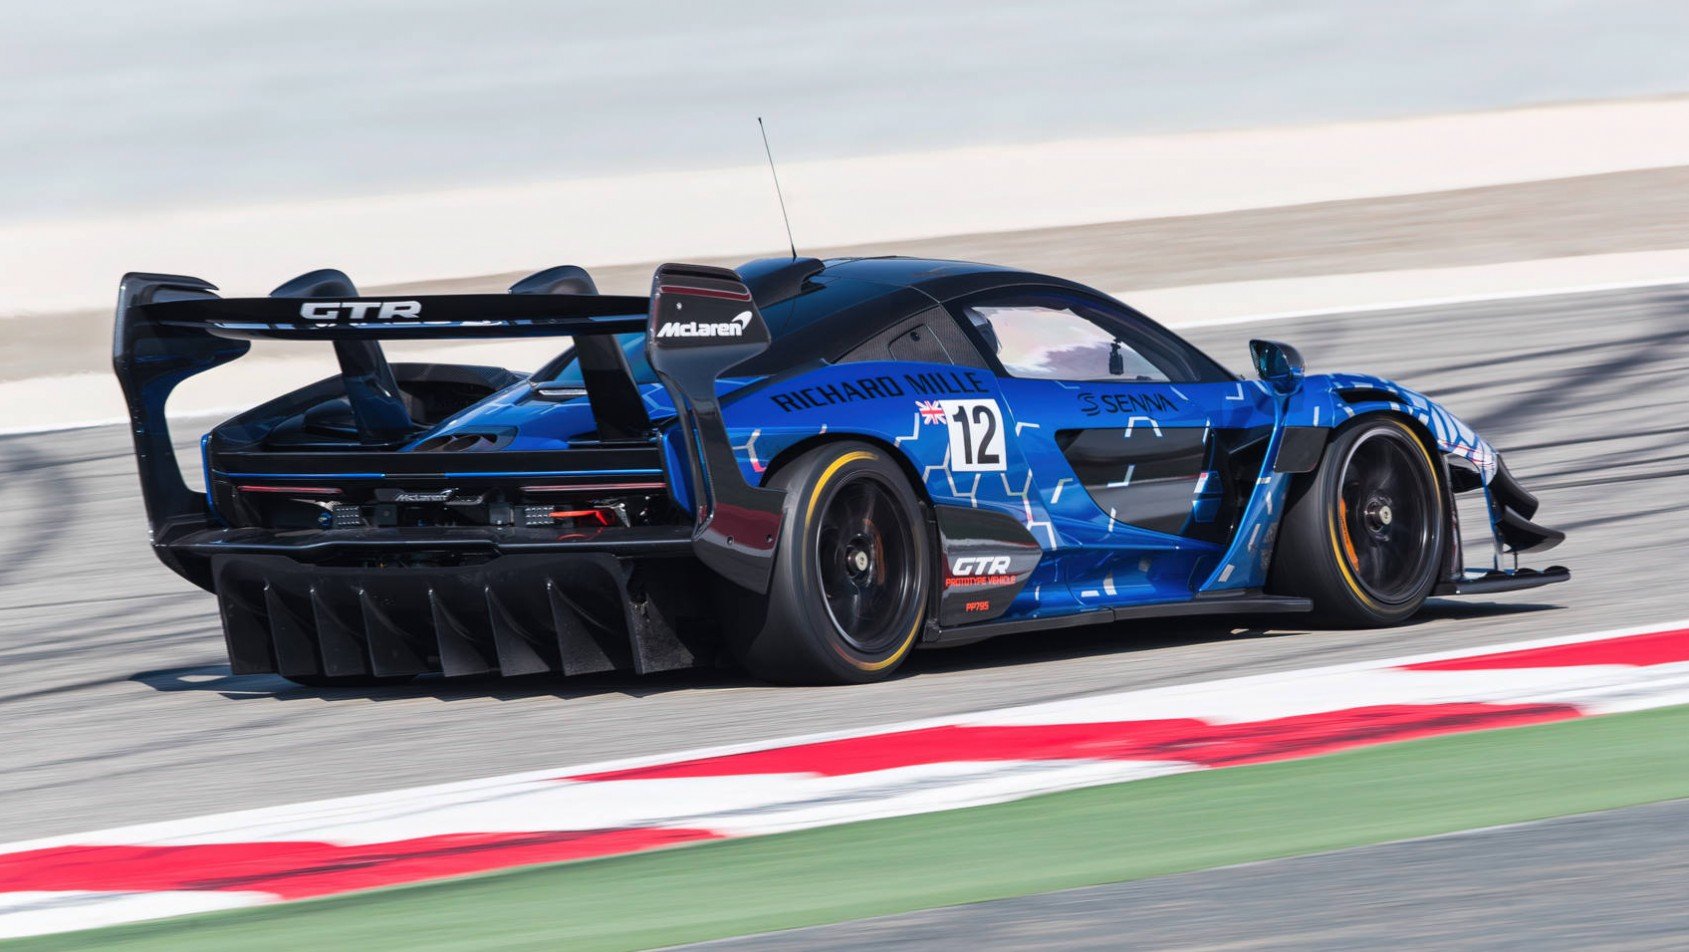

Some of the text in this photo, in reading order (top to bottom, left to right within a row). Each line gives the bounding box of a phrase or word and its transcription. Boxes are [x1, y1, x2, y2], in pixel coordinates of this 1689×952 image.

[300, 301, 422, 320] GTR
[656, 320, 744, 338] McLaren
[769, 371, 990, 413] RICHARD MILLE
[1100, 393, 1179, 414] SENNA
[952, 405, 1000, 465] 12
[952, 555, 1011, 576] GTR
[945, 575, 1017, 587] PROTOTYPE VEHICLE
